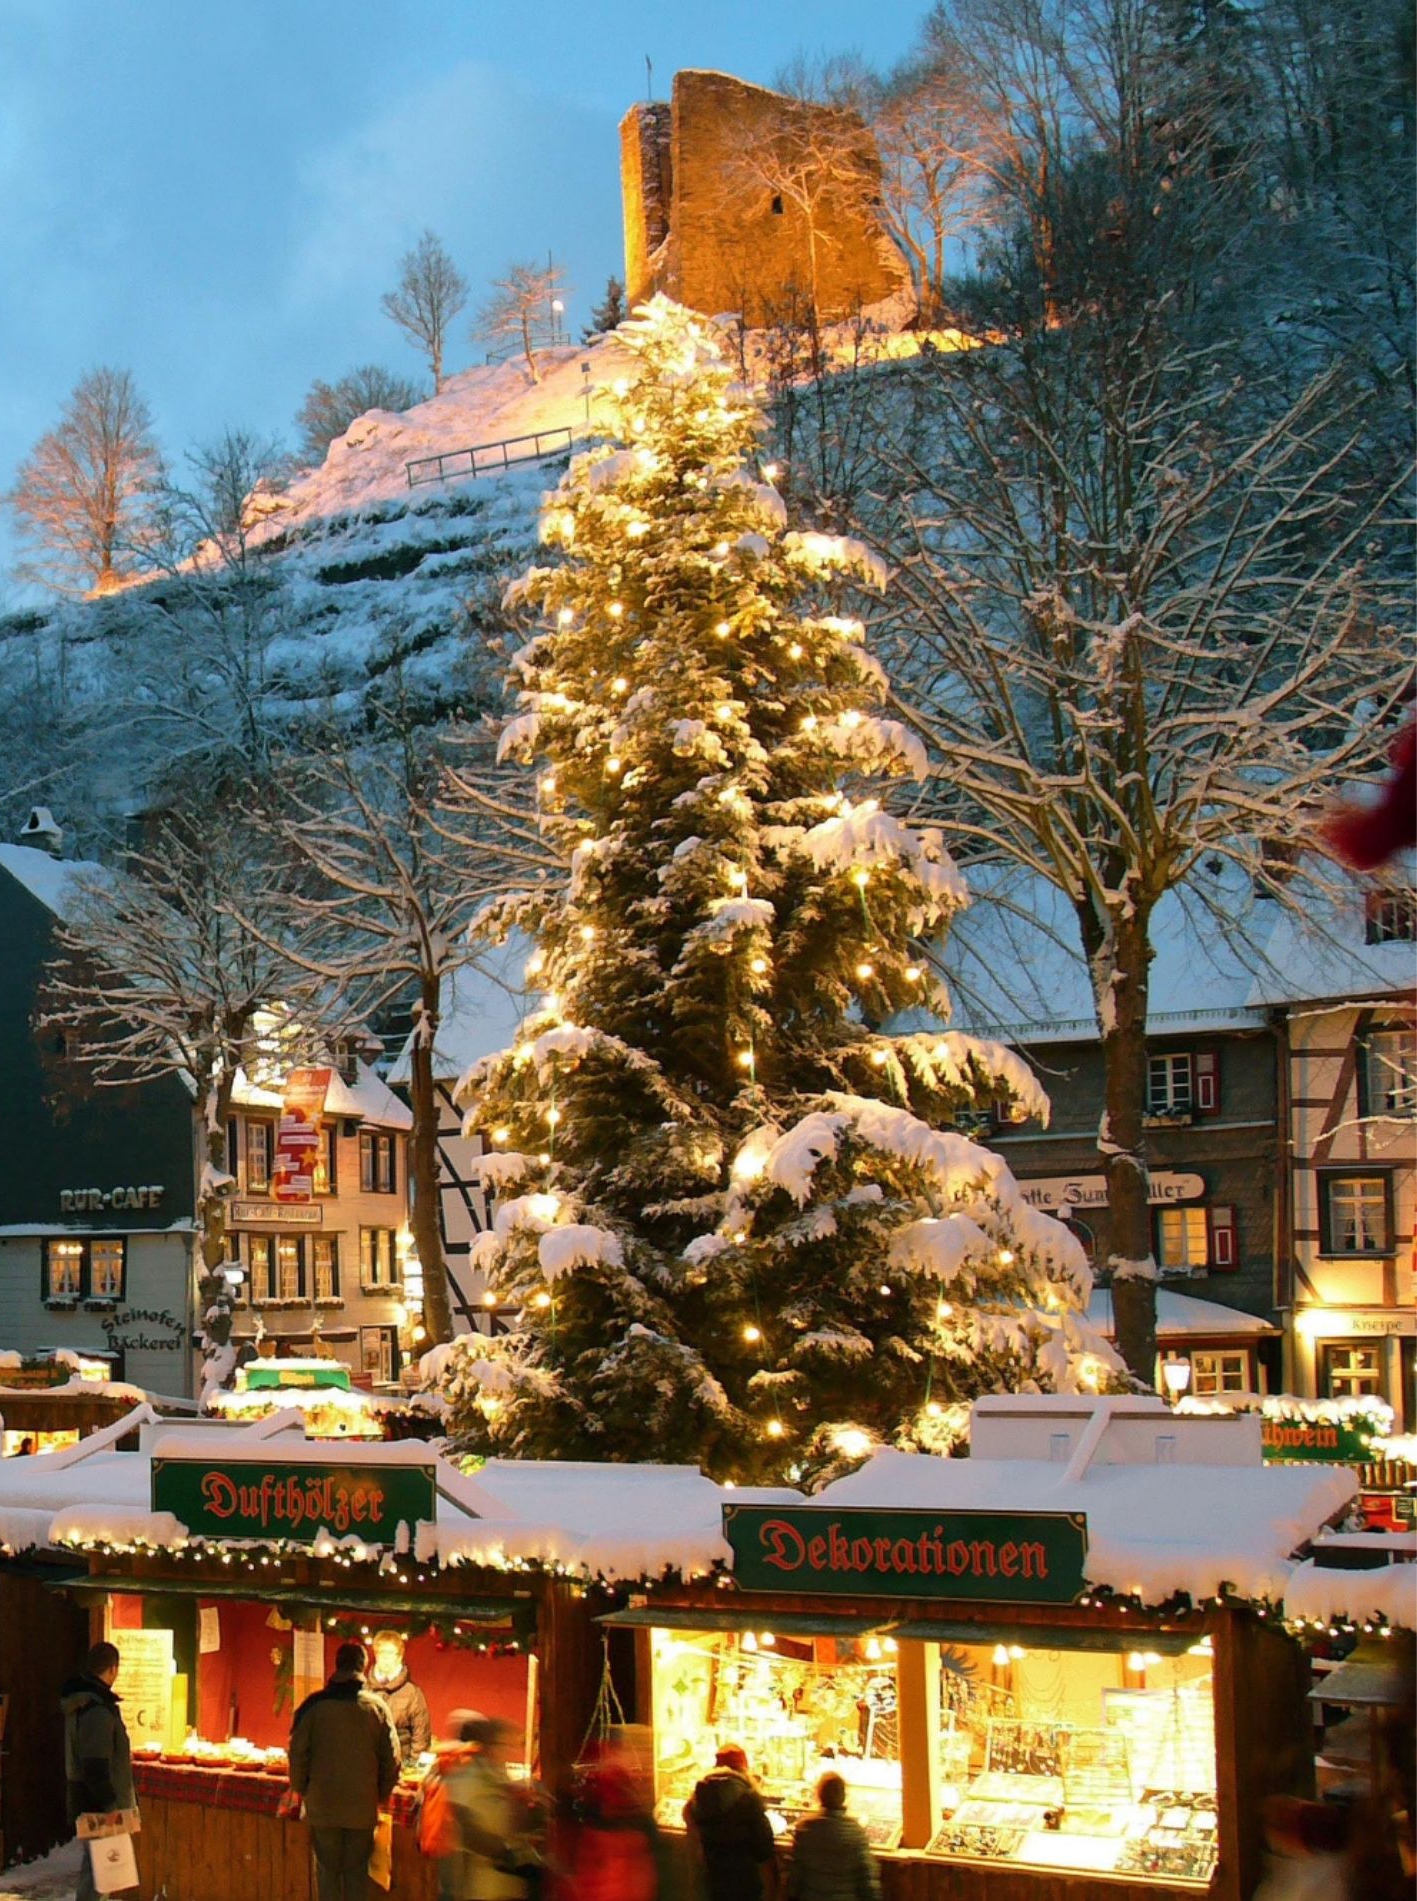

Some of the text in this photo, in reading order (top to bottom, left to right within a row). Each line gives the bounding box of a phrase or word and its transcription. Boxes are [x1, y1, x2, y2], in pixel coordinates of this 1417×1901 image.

[101, 1307, 186, 1336] Steinofen
[1352, 1319, 1403, 1334] Kneipe
[107, 1332, 181, 1350] Bäckerei
[201, 1471, 385, 1531] Dufthölzer
[758, 1519, 1049, 1579] Dekorationen
